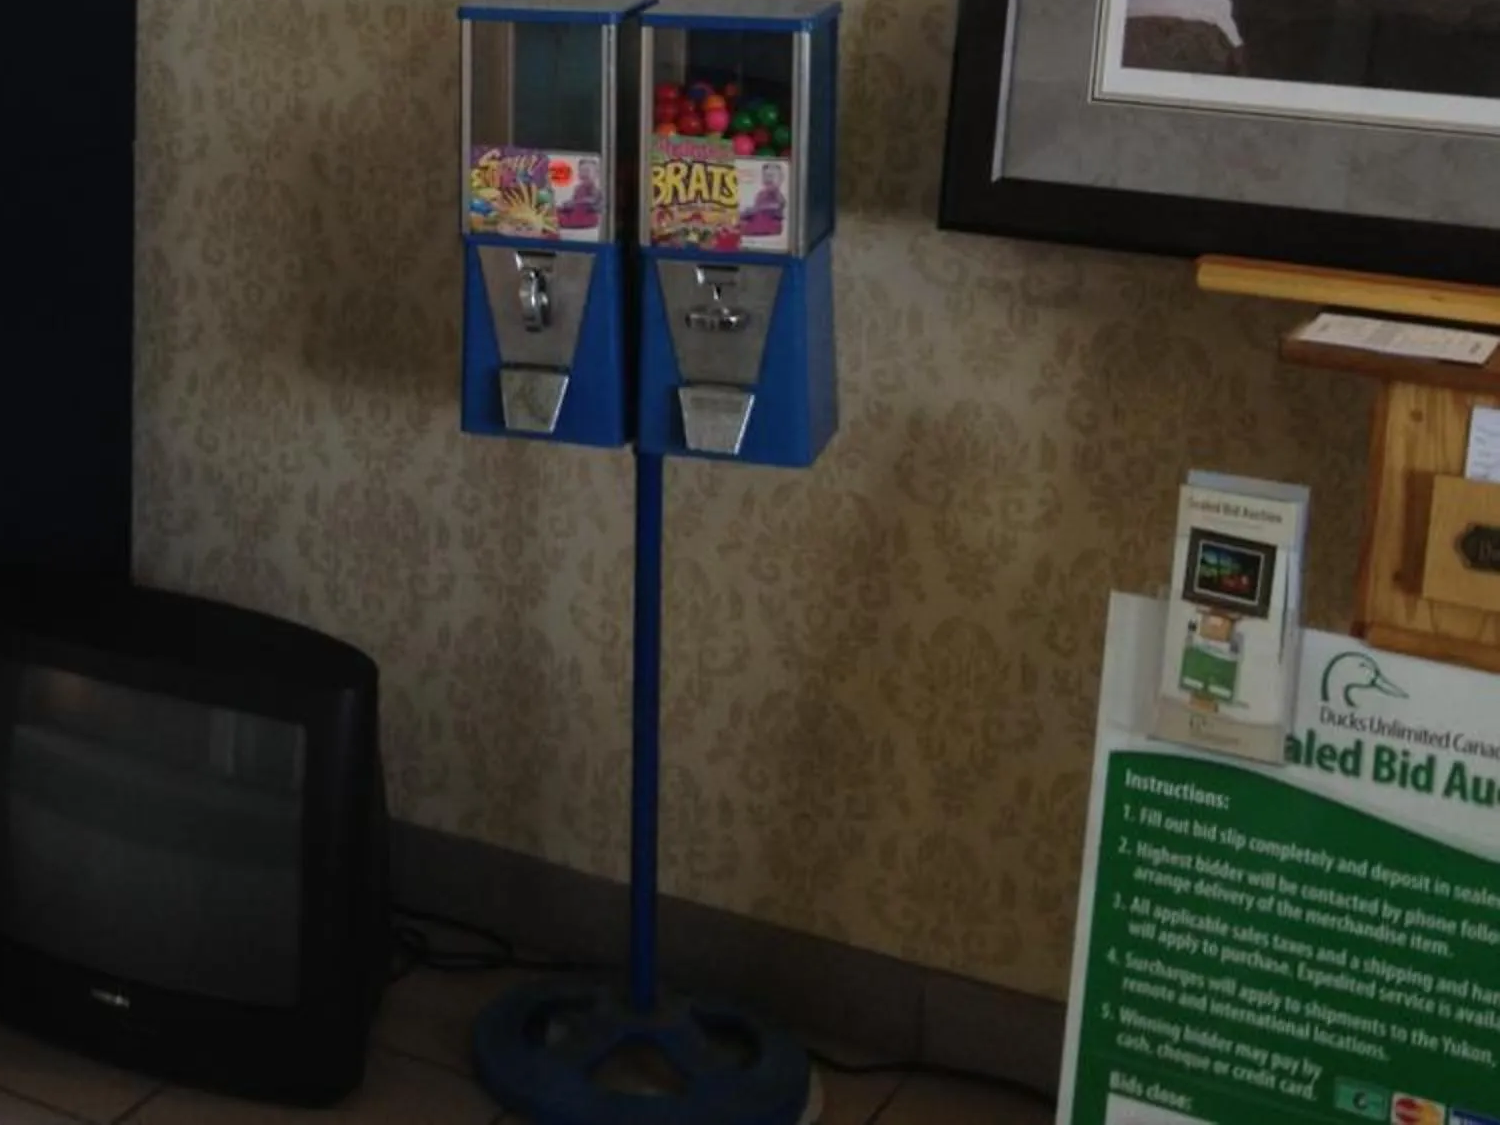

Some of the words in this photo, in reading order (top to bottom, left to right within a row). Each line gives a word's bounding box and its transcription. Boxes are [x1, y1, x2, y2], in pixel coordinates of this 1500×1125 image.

[650, 159, 738, 207] BRATS
[1242, 506, 1283, 525] Auction
[1284, 728, 1364, 779] aled
[1372, 744, 1437, 795] Bid
[1442, 760, 1500, 809] Au
[1320, 705, 1368, 733] Ducks
[1369, 714, 1451, 750] Unlimited
[1125, 768, 1230, 810] Instructions:
[1118, 835, 1132, 856] 2.
[1136, 839, 1193, 870] Highest
[1195, 854, 1244, 881] bidder
[1248, 871, 1277, 891] will
[1278, 875, 1298, 896] be
[1301, 884, 1380, 917] contacted
[1381, 899, 1402, 925] by
[1404, 908, 1458, 936] phone
[1123, 803, 1136, 823] 1.
[1140, 806, 1162, 828] Fill
[1164, 816, 1190, 835] out
[1193, 819, 1218, 842] bid
[1220, 827, 1247, 851] slip
[1249, 836, 1335, 873] completely
[1336, 858, 1369, 879] and
[1371, 863, 1431, 894] deposit
[1433, 876, 1451, 898] in
[1453, 885, 1500, 911] seale
[1113, 891, 1127, 911] 3.
[1129, 895, 1151, 916] All
[1152, 904, 1229, 937] applicable
[1231, 925, 1270, 949] sales
[1271, 933, 1314, 959] taxes
[1315, 947, 1348, 968] and
[1350, 955, 1361, 971] a
[1362, 956, 1434, 993] shipping
[1435, 976, 1470, 999] and
[1133, 866, 1193, 895] arrange
[1194, 880, 1255, 912] delivery
[1256, 895, 1275, 913] of
[1276, 899, 1303, 921] the
[1304, 908, 1408, 947] merchandise
[1409, 931, 1455, 959] item.
[1124, 950, 1205, 988] Surcharges
[1208, 976, 1238, 997] will
[1238, 985, 1283, 1012] apply
[1285, 995, 1301, 1014] to
[1304, 1000, 1387, 1038] shipments
[1389, 1024, 1408, 1043] to
[1410, 1027, 1438, 1052] the
[1441, 1034, 1497, 1069] Yukon,
[1127, 919, 1157, 940] will
[1158, 930, 1199, 955] apply
[1202, 938, 1219, 957] to
[1220, 945, 1294, 978] purchase.
[1296, 960, 1377, 1000] Expedited
[1378, 986, 1436, 1014] service
[1437, 1000, 1453, 1020] is
[1118, 1006, 1182, 1044] Winning
[1182, 1024, 1235, 1053] bidder
[1234, 1041, 1270, 1067] may
[1270, 1052, 1300, 1076] pay
[1301, 1057, 1324, 1088] by
[1122, 975, 1177, 1003] remote
[1177, 992, 1208, 1013] and
[1209, 999, 1312, 1040] international
[1312, 1025, 1391, 1063] locations.
[1109, 1070, 1144, 1097] Bids
[1145, 1082, 1193, 1111] close:
[1156, 1042, 1211, 1073] cheque
[1212, 1058, 1231, 1075] or
[1232, 1064, 1276, 1090] credit
[1278, 1074, 1319, 1102] card.
